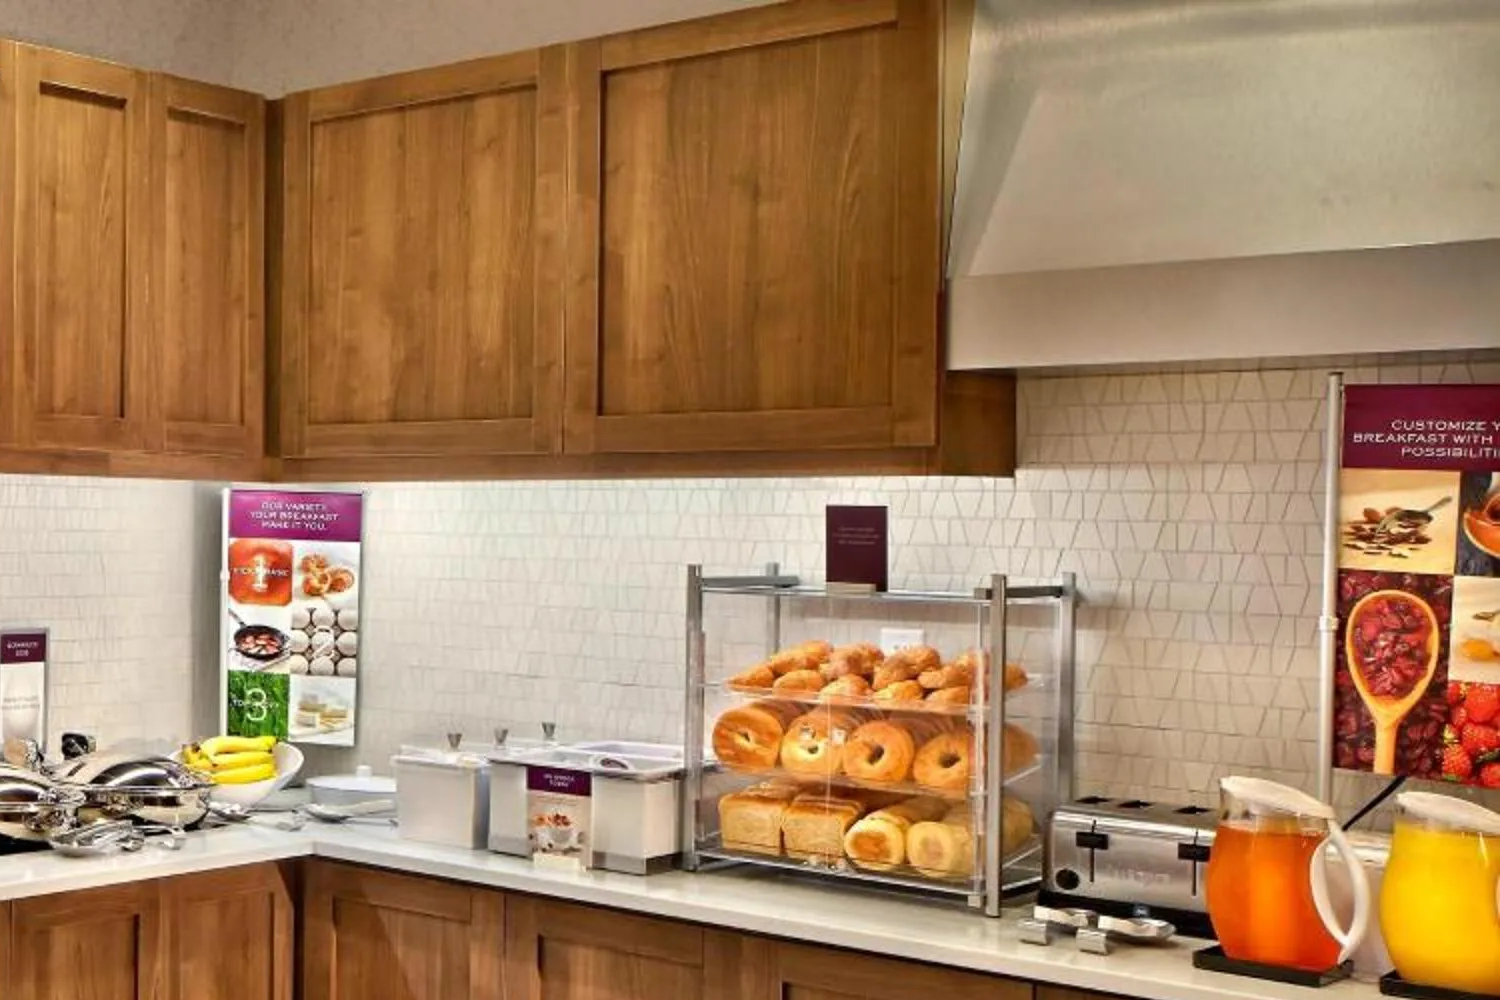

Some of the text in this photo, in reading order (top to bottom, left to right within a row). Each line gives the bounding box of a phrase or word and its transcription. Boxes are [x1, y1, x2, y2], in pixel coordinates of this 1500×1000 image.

[1391, 420, 1487, 431] CUSTOMIZE
[1353, 433, 1494, 444] BREAKFAST WITH
[280, 511, 339, 521] BREAKFAST
[245, 686, 268, 722] 3
